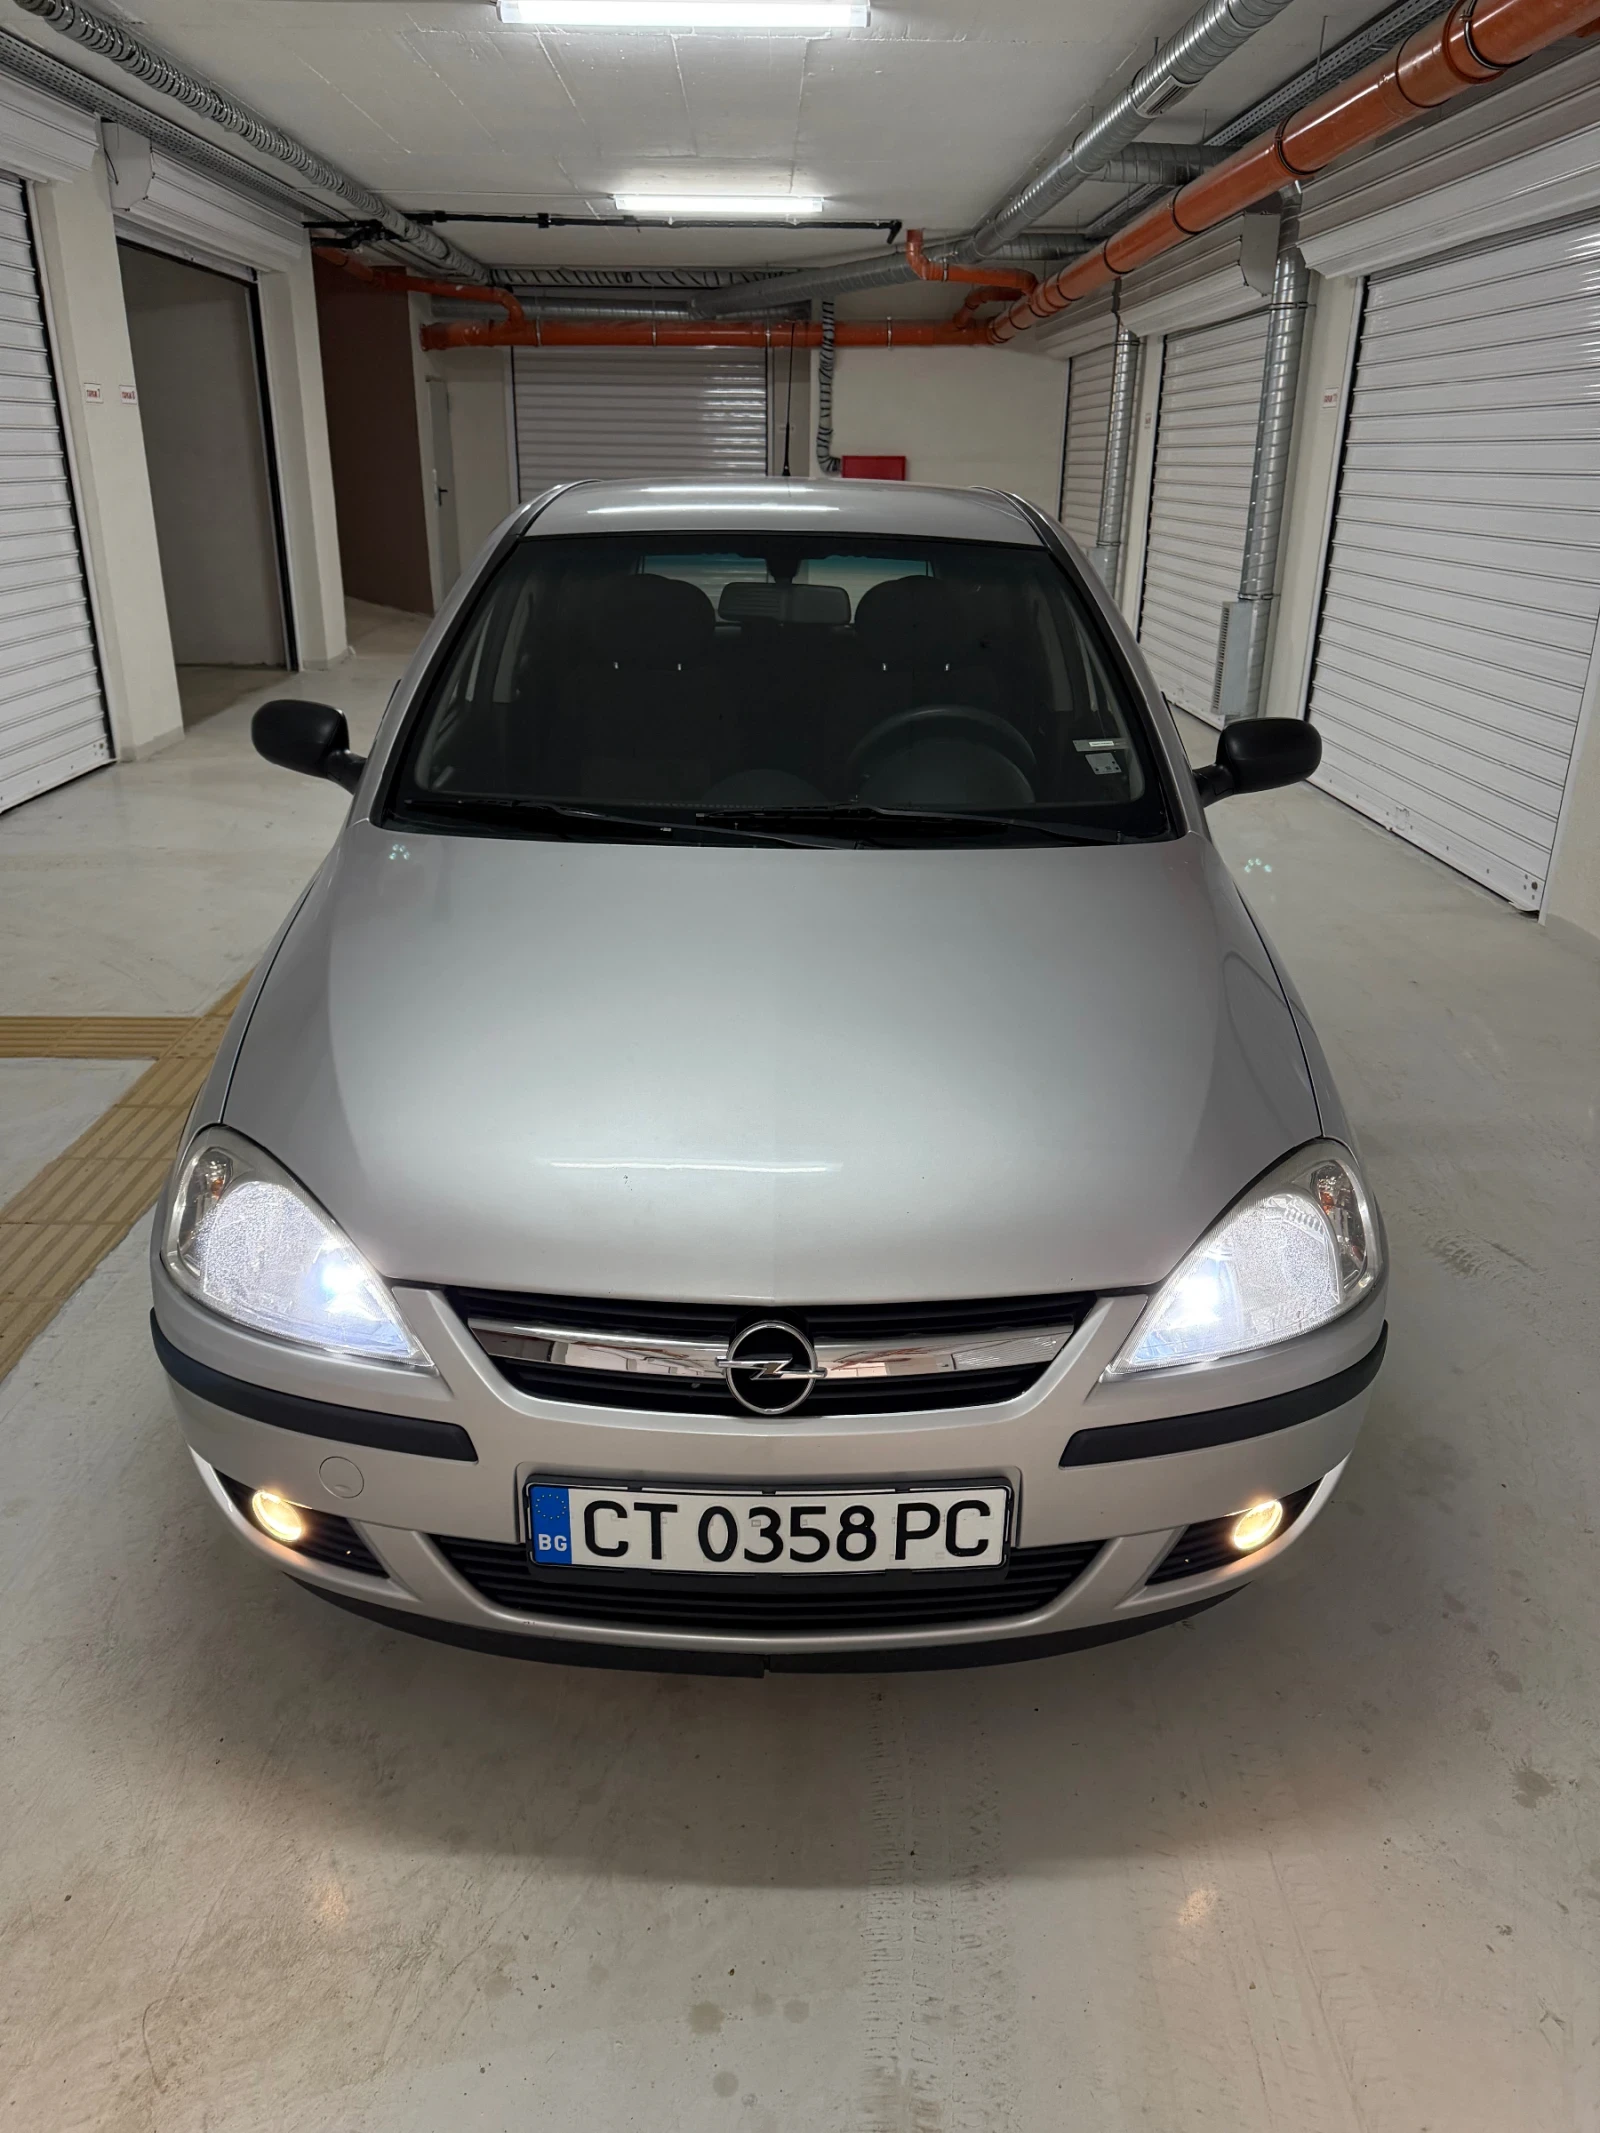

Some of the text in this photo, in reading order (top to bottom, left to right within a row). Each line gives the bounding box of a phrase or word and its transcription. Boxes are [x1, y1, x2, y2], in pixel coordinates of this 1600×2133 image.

[538, 1533, 568, 1553] BG
[584, 1500, 991, 1564] CT 0358 PC
